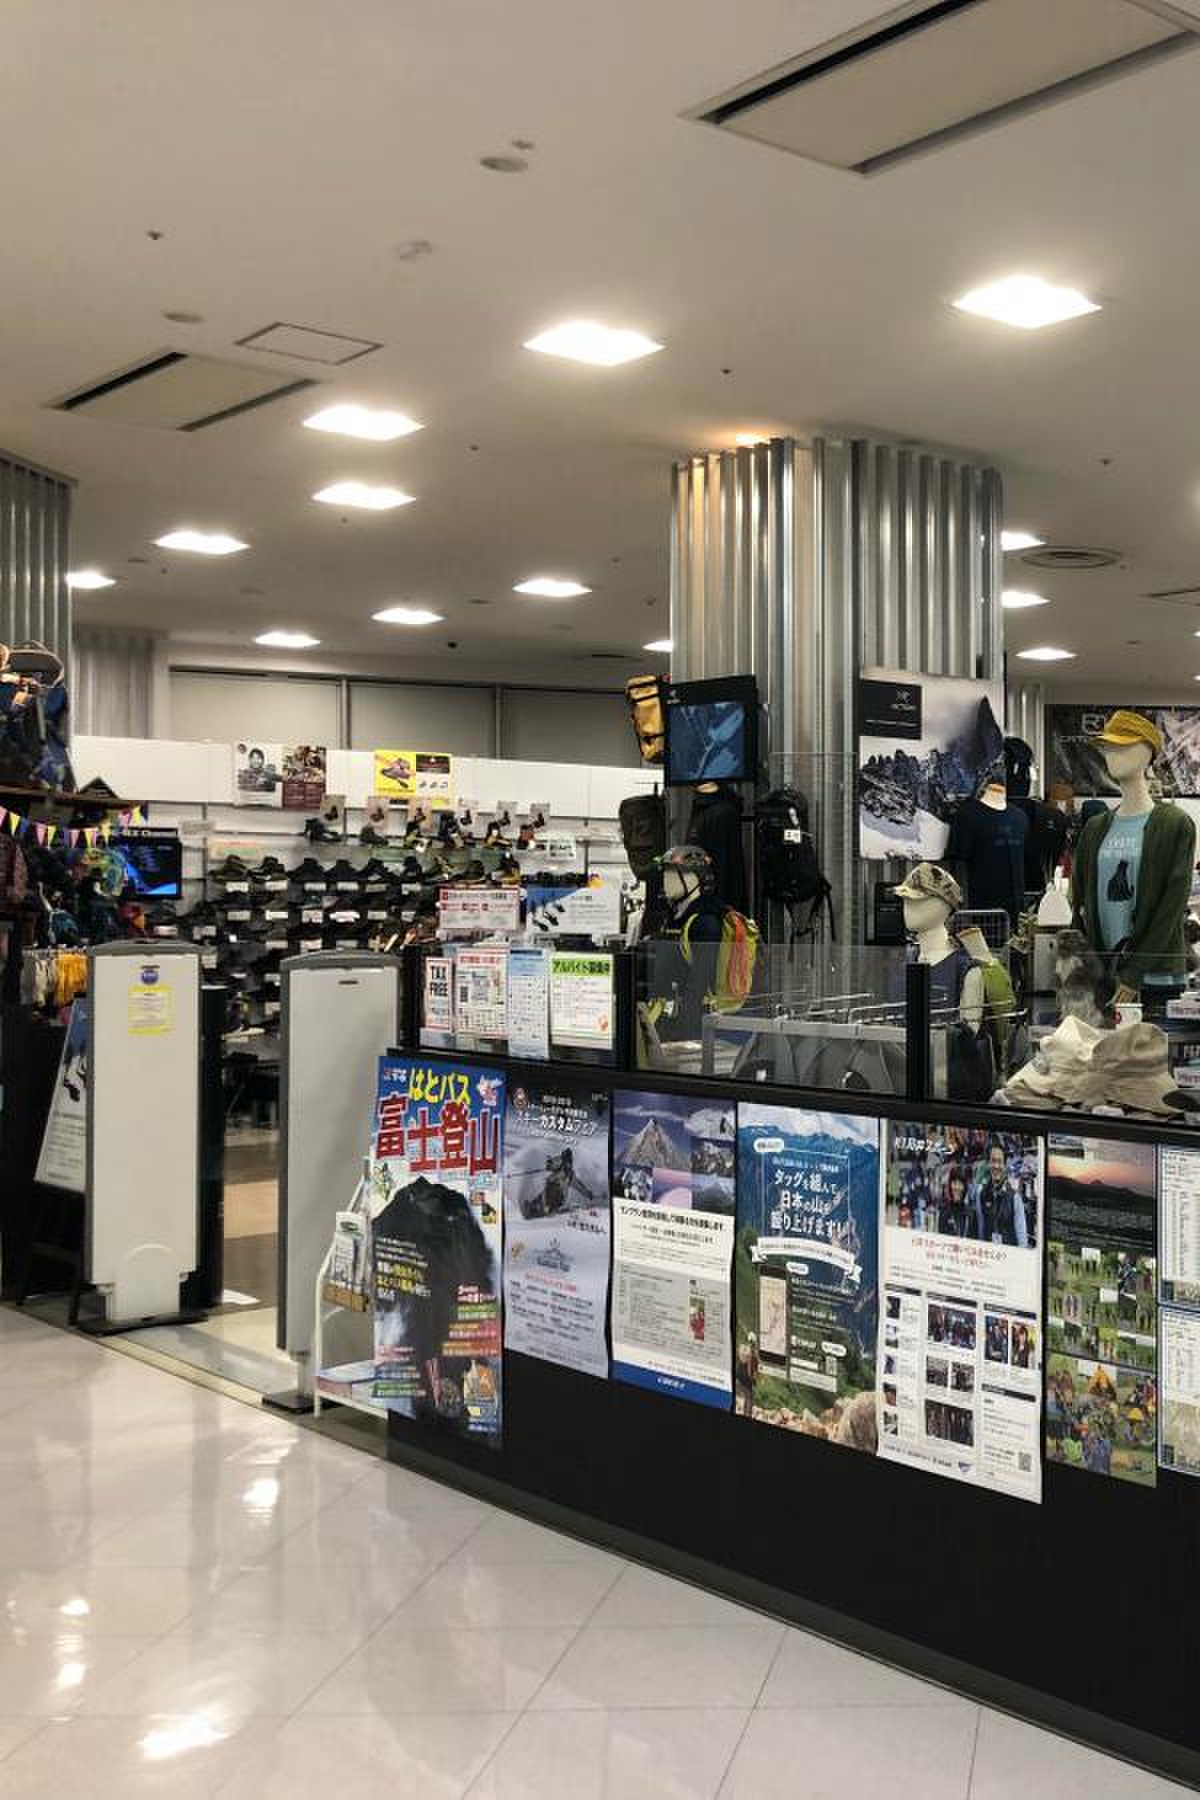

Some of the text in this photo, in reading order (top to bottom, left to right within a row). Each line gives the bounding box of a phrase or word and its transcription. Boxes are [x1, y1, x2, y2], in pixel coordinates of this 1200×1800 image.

[430, 965, 447, 981] TAX
[409, 1067, 471, 1105] はとバス
[376, 1092, 500, 1176] 富士登山
